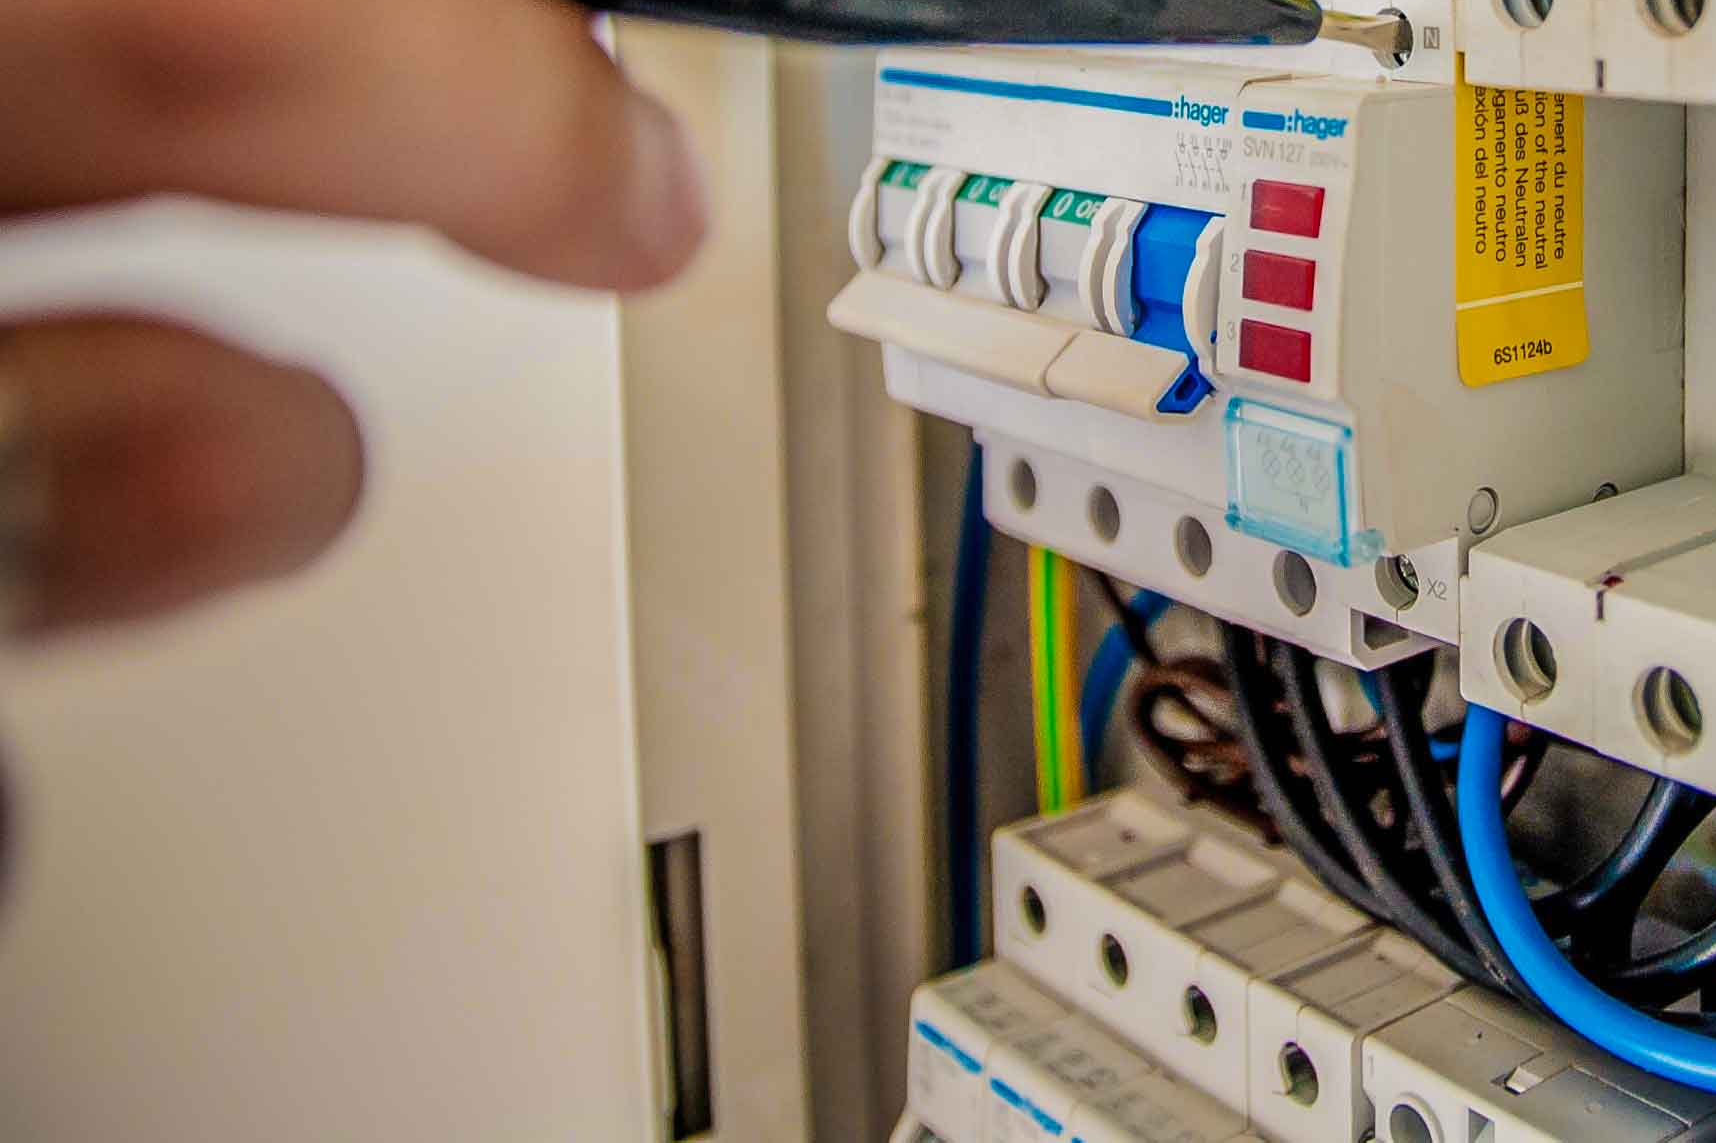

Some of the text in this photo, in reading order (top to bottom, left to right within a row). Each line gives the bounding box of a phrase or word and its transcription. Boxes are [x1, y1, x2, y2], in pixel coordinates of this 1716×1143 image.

[1424, 26, 1440, 49] N
[1243, 137, 1274, 159] SVN
[1279, 141, 1304, 163] 127
[1514, 122, 1528, 161] des
[1535, 134, 1548, 154] of
[1474, 147, 1488, 179] del
[1535, 160, 1548, 194] the
[1554, 161, 1567, 188] du
[1475, 186, 1488, 254] neutro
[1495, 194, 1508, 262] neutro
[1515, 168, 1529, 268] Neutralen
[1554, 194, 1567, 259] neutre
[1535, 200, 1548, 269] neutral
[1230, 253, 1240, 273] 2
[1227, 321, 1237, 341] 3
[1494, 339, 1552, 365] 6S1124b
[1427, 577, 1448, 601] X2
